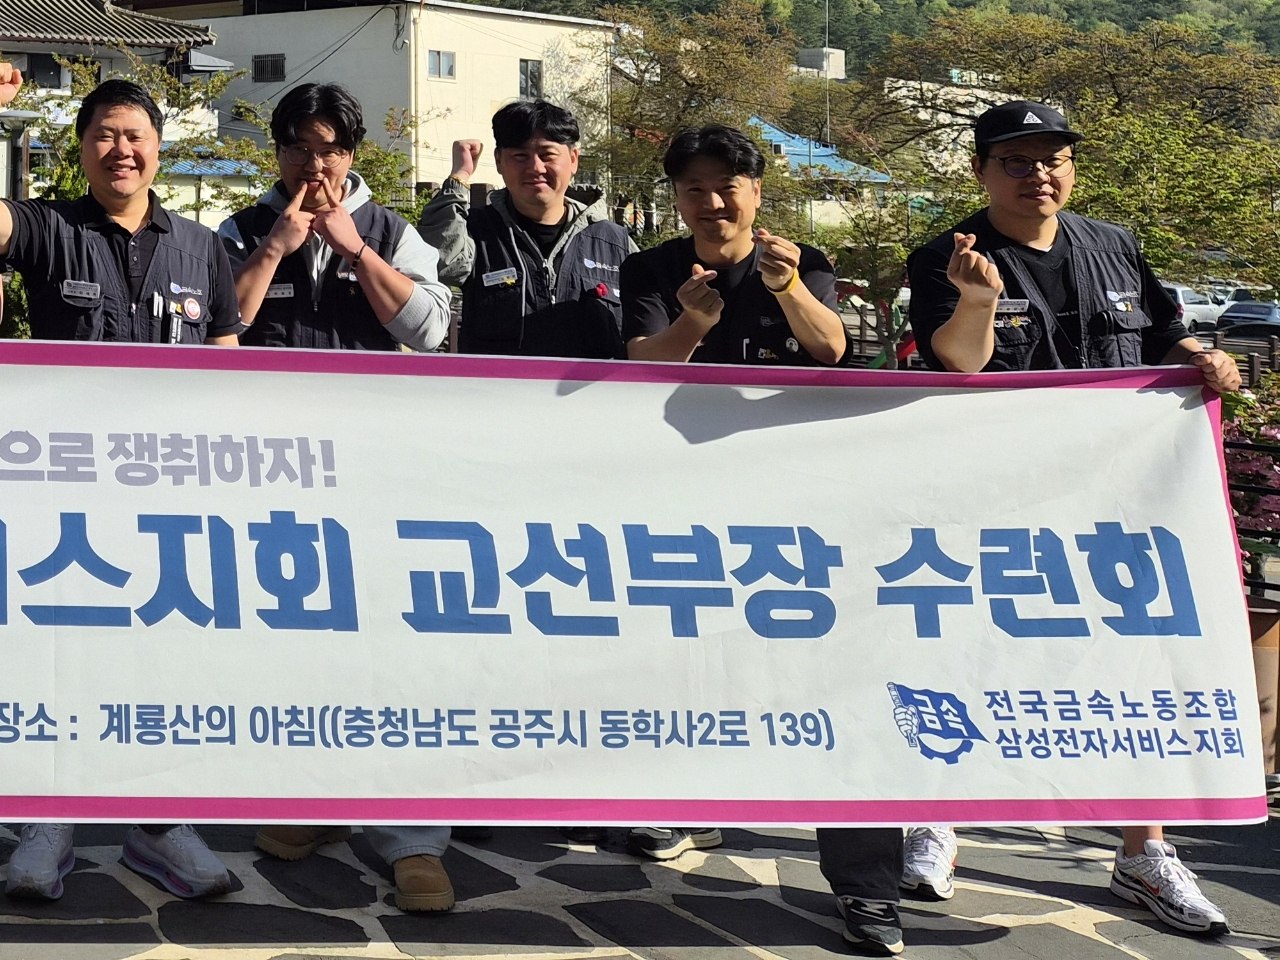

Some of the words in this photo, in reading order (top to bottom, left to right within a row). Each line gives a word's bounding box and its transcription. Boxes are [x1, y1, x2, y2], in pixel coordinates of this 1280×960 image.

[108, 433, 338, 488] 쟁취하자!
[396, 519, 844, 639] 교선부장
[875, 522, 1203, 639] 수련회
[99, 704, 236, 746] 계룡산의
[489, 710, 587, 748] 공주시
[600, 710, 750, 748] 동학사2로
[760, 709, 835, 751] 139)
[912, 693, 969, 737] 금속
[984, 689, 1238, 722] 전국금속노동조합
[995, 727, 1245, 759] 삼성전자서비스지회
